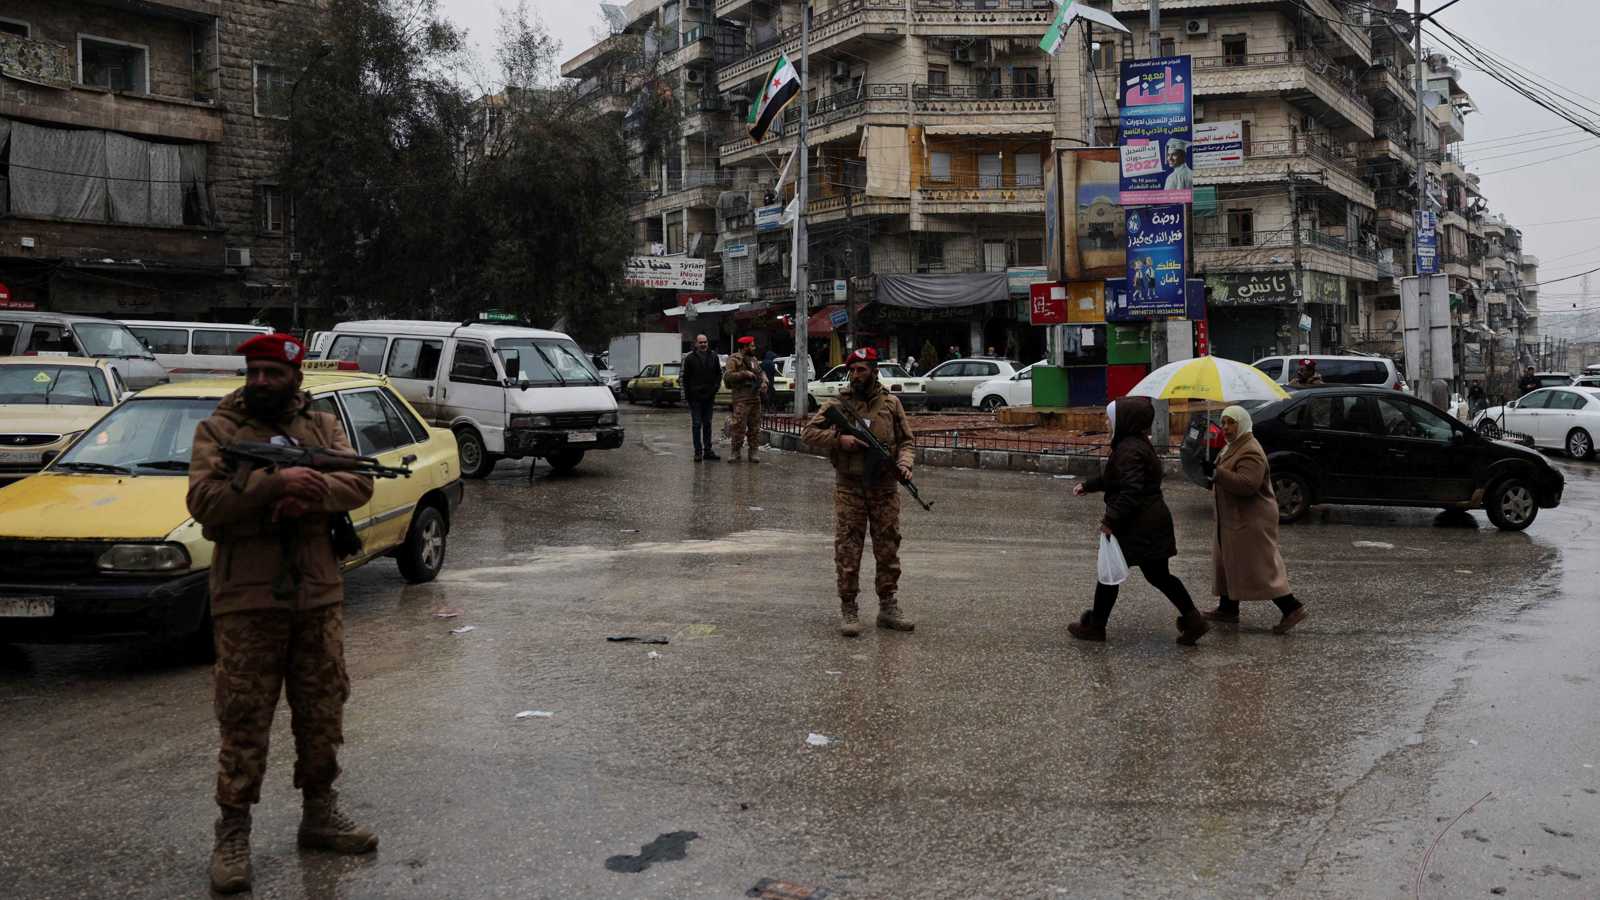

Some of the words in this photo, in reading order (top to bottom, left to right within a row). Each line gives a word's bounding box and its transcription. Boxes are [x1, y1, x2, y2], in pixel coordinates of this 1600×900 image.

[1142, 73, 1165, 81] معهد
[1145, 117, 1167, 126] التسجيل
[1125, 146, 1147, 156] التسجيل
[1125, 159, 1160, 173] 2027
[1152, 212, 1180, 225] روضة
[1168, 230, 1183, 245] قطر
[680, 262, 704, 270] Syrian
[1155, 259, 1181, 270] طفلك
[1160, 271, 1180, 286] بأمان
